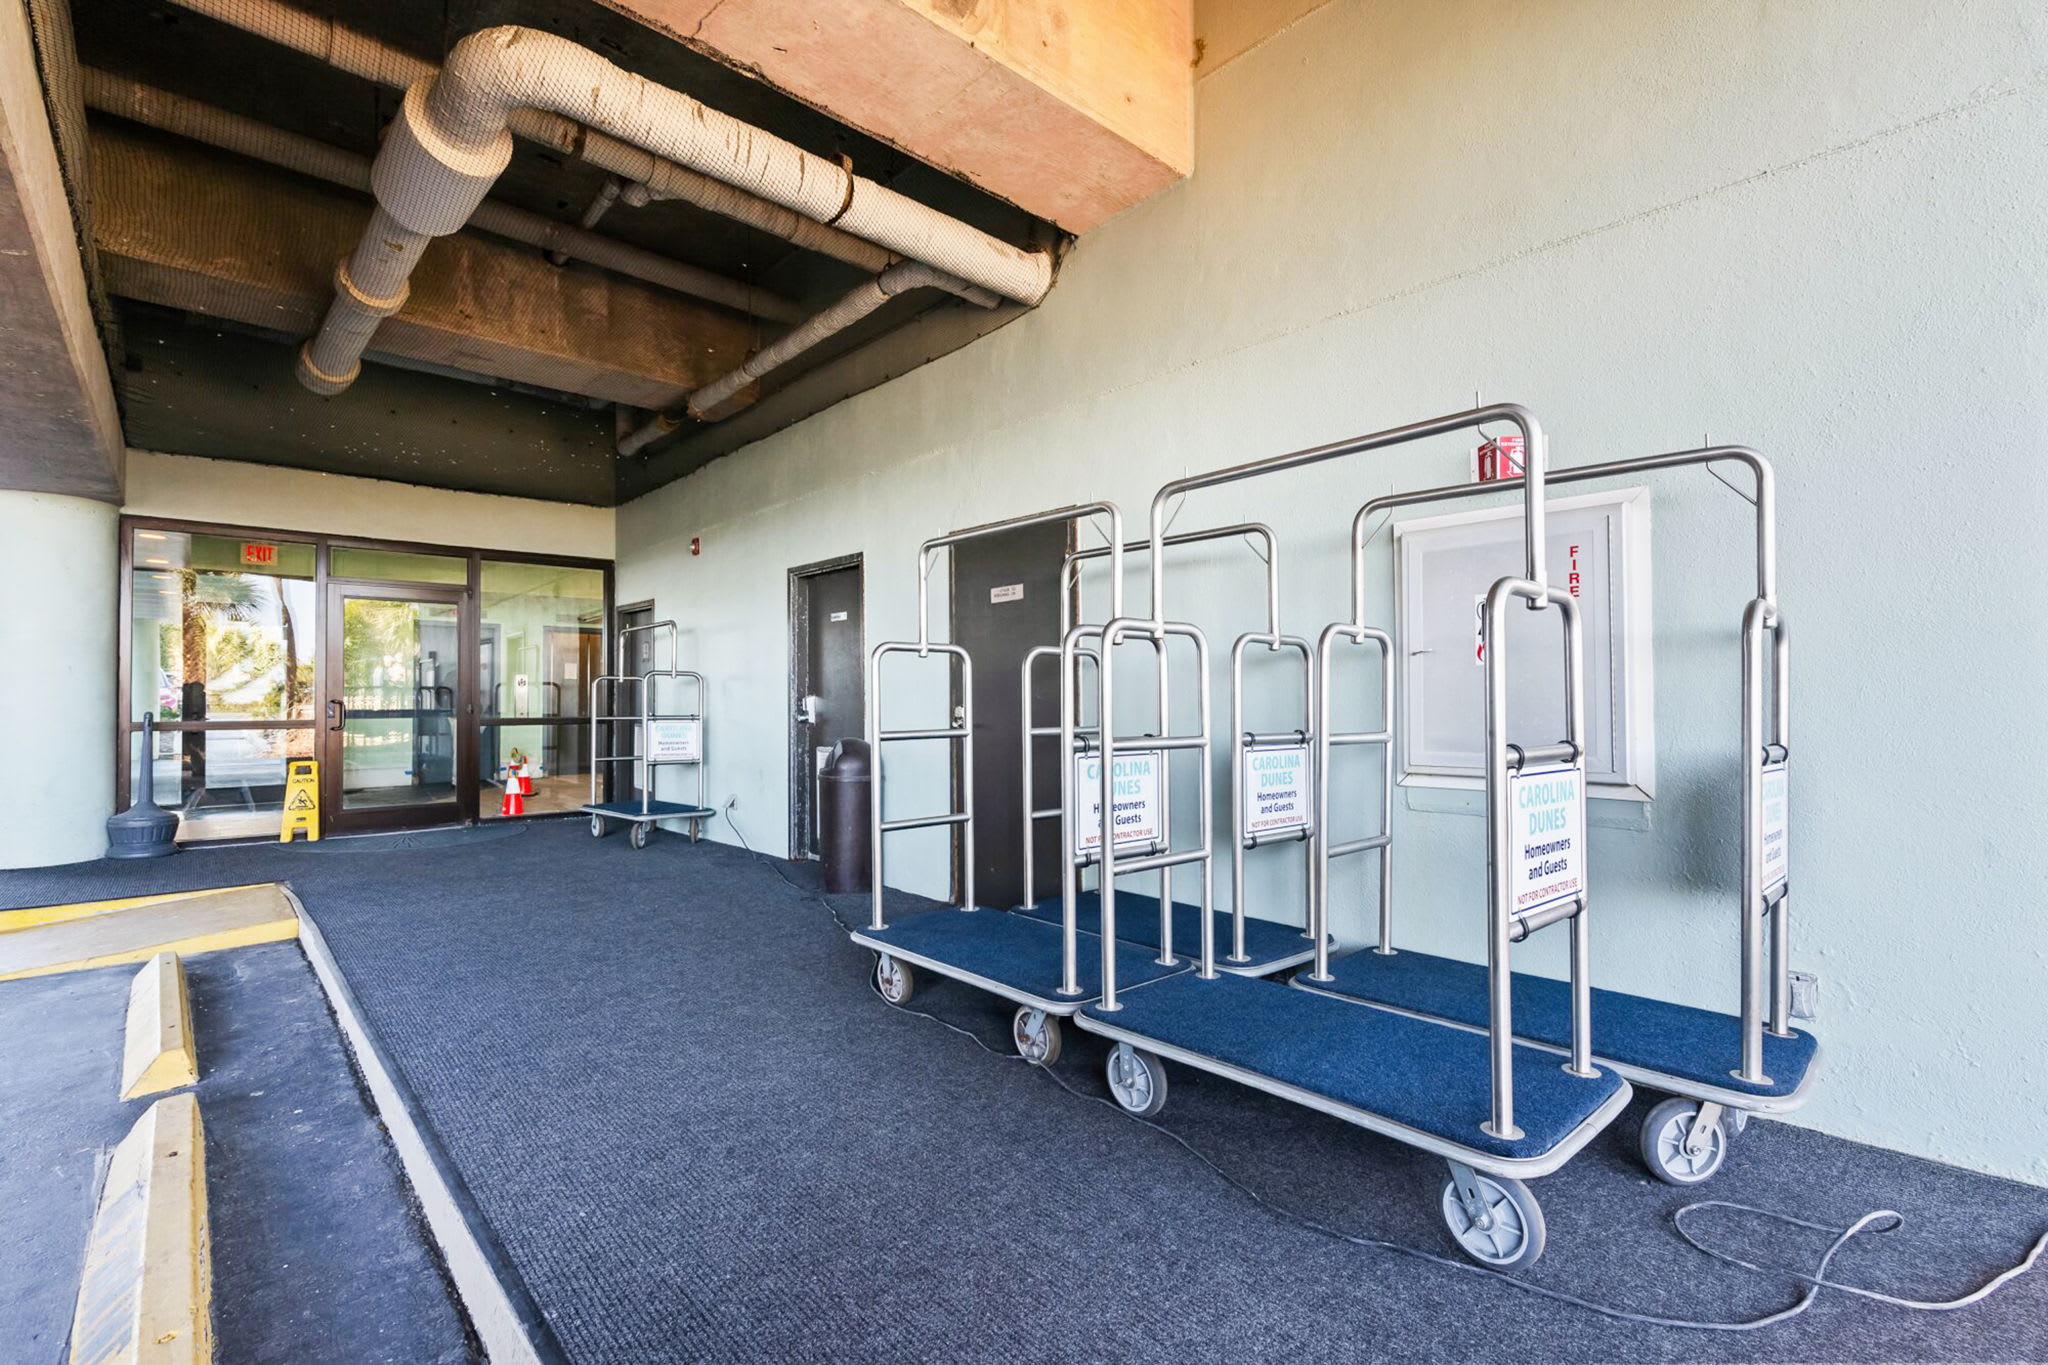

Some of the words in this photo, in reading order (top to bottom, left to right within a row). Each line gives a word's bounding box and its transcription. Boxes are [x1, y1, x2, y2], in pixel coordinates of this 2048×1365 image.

[247, 545, 272, 561] EXIT
[1569, 545, 1580, 598] FIRE
[1087, 761, 1151, 779] CAOLINA
[1253, 754, 1301, 771] CAROLINA
[1261, 771, 1293, 787] DUNES
[1257, 790, 1297, 802] Homeowners
[1519, 780, 1575, 809] CAROLINA
[1093, 800, 1146, 814] Heowners
[1261, 803, 1272, 814] and
[1274, 802, 1294, 813] Guests
[1115, 814, 1142, 825] Guests
[1529, 808, 1566, 835] DUNES
[1113, 829, 1142, 840] ONTRACTOR
[1143, 828, 1153, 836] USE
[1524, 838, 1571, 860] Homeowners
[1528, 861, 1543, 880] and
[1544, 858, 1567, 876] Guests
[1517, 893, 1528, 905] NOT
[1529, 890, 1539, 902] FOR
[1539, 880, 1569, 898] CONTRACTOR
[1569, 877, 1578, 888] USE
